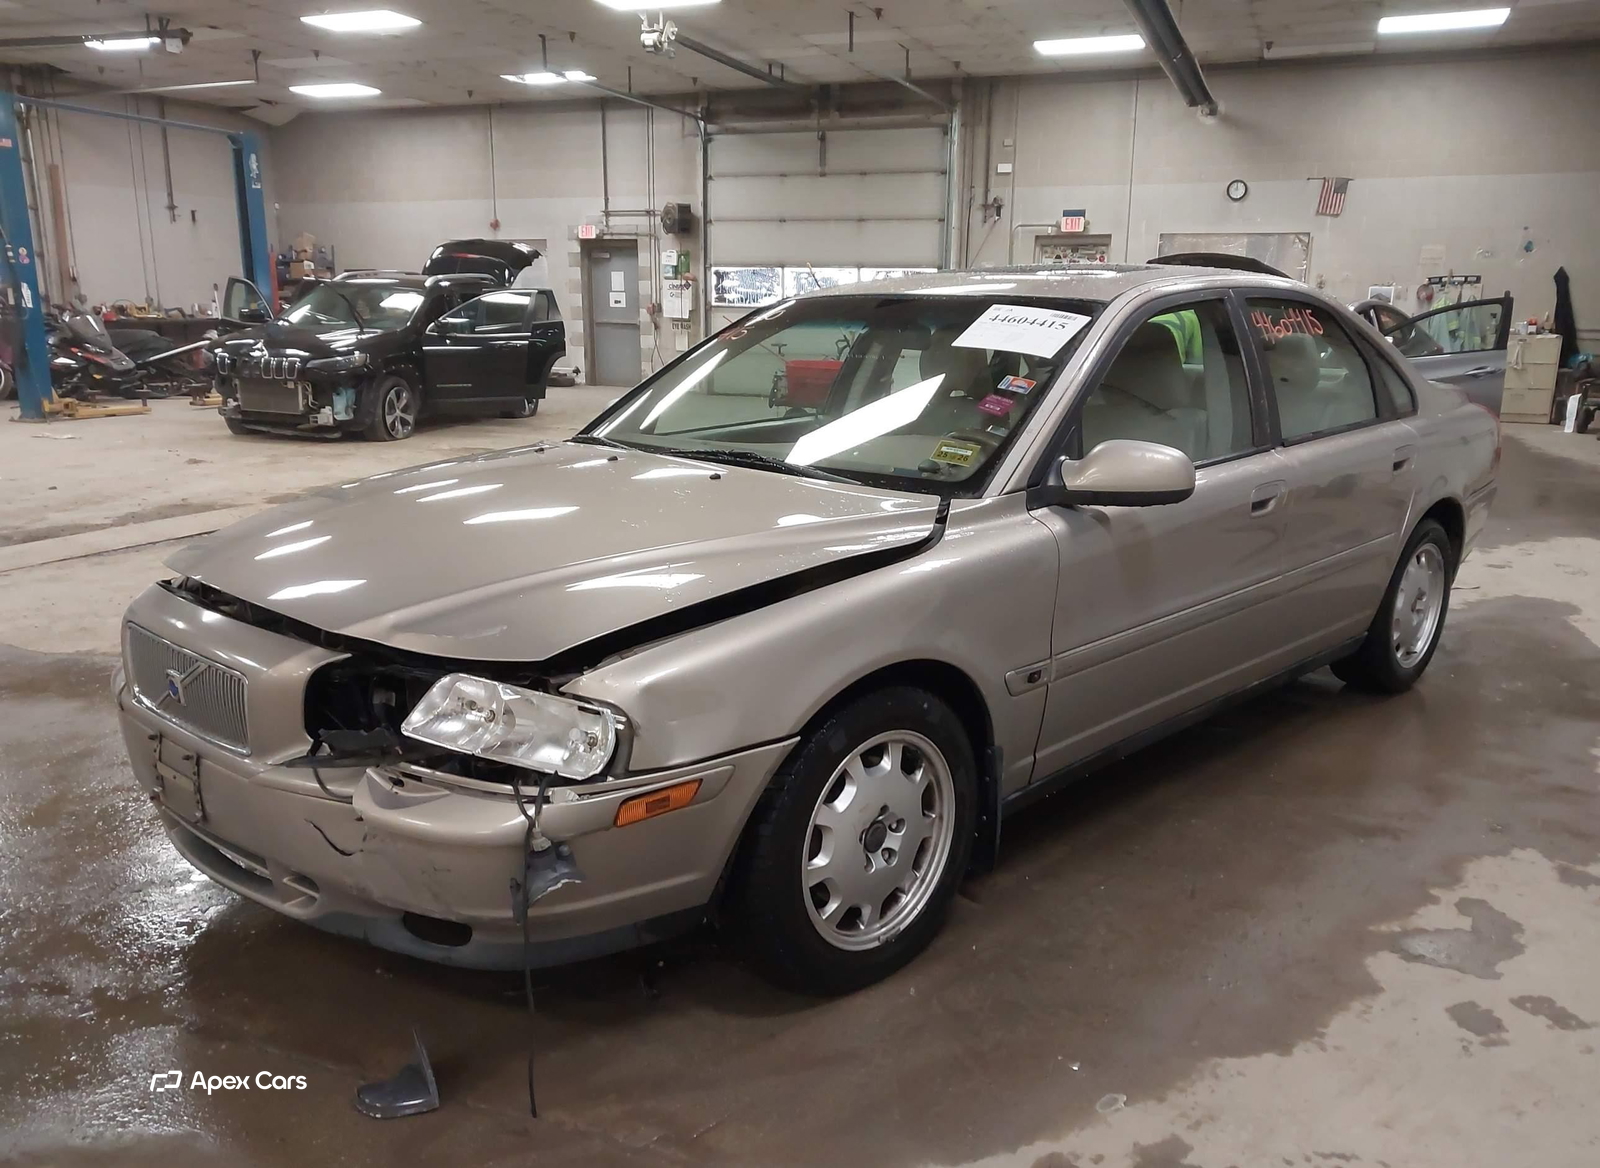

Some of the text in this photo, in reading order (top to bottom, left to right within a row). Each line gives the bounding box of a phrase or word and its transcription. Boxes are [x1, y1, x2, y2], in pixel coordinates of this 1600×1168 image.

[1065, 217, 1081, 230] EXIT
[581, 226, 593, 238] EXIT
[989, 314, 1069, 330] 44604415
[1250, 307, 1324, 345] 44604415
